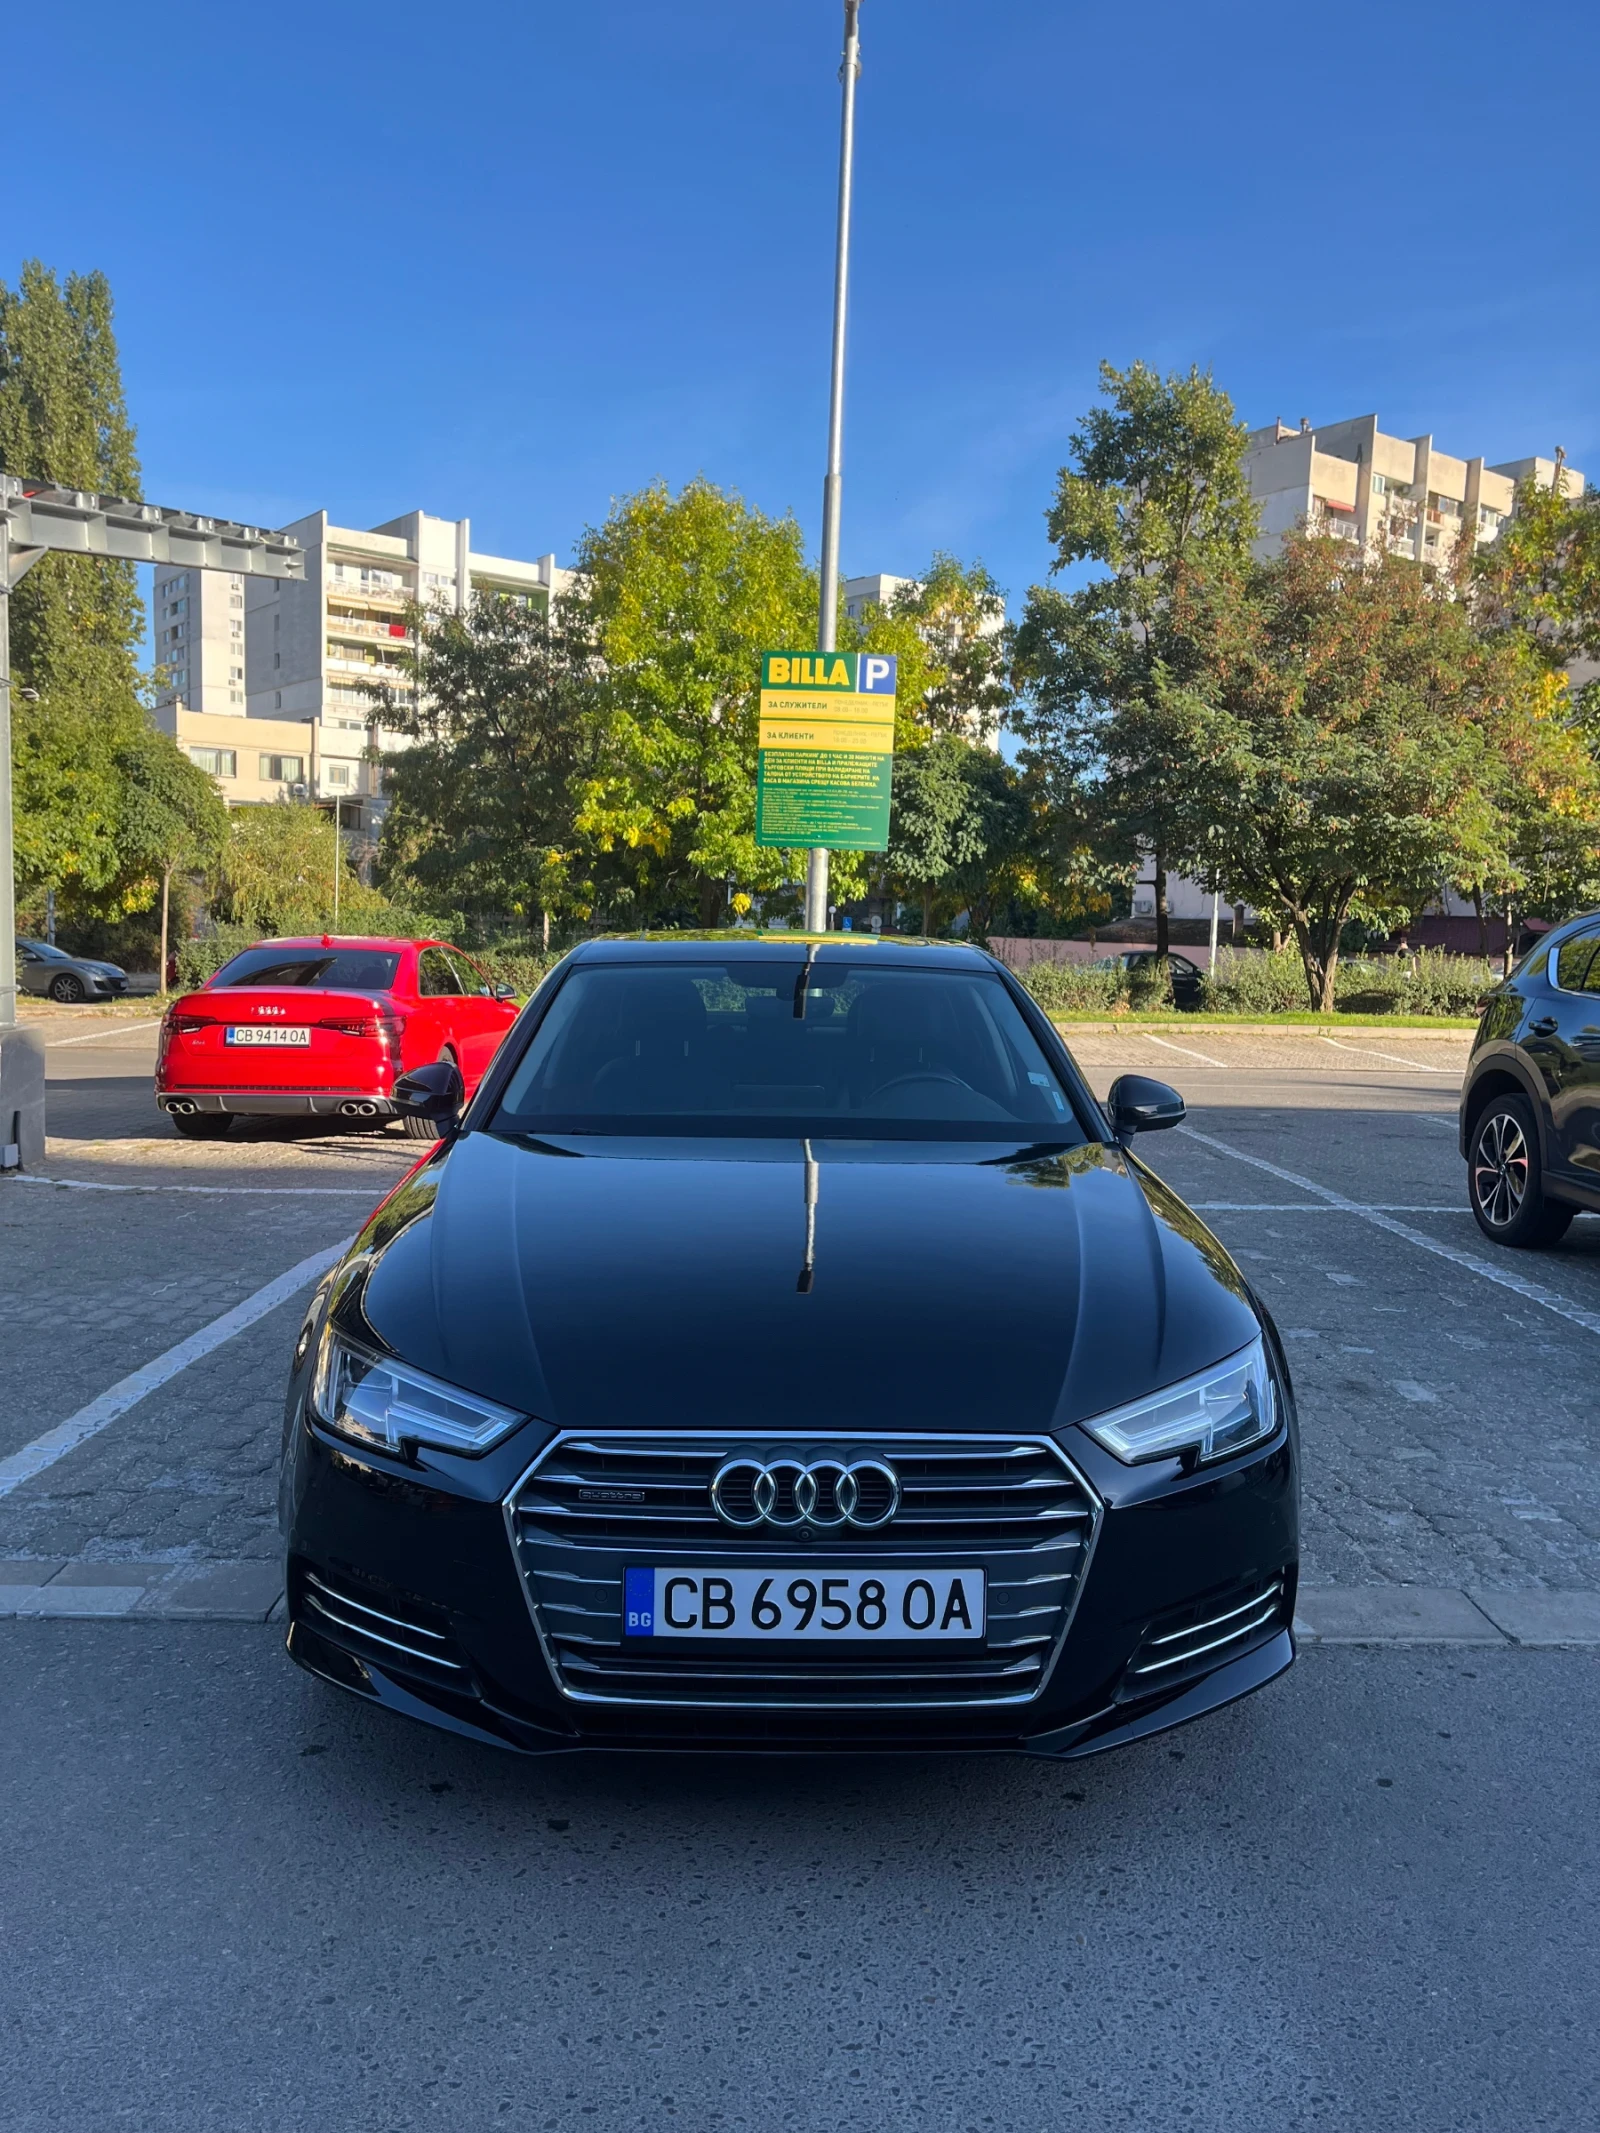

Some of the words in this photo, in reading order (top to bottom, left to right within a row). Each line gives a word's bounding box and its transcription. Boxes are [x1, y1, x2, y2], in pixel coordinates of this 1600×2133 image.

[768, 657, 850, 686] BILLA
[866, 658, 890, 689] P
[780, 701, 828, 710] СЛУЖИТЕЛИ
[766, 731, 777, 740] ЗА
[778, 732, 814, 740] КЛИЕНТИ
[236, 1029, 253, 1042] CB
[256, 1029, 287, 1042] 9414
[582, 1491, 642, 1500] quattro
[664, 1577, 736, 1630] CB
[751, 1578, 888, 1631] 6958
[628, 1611, 652, 1628] BG
